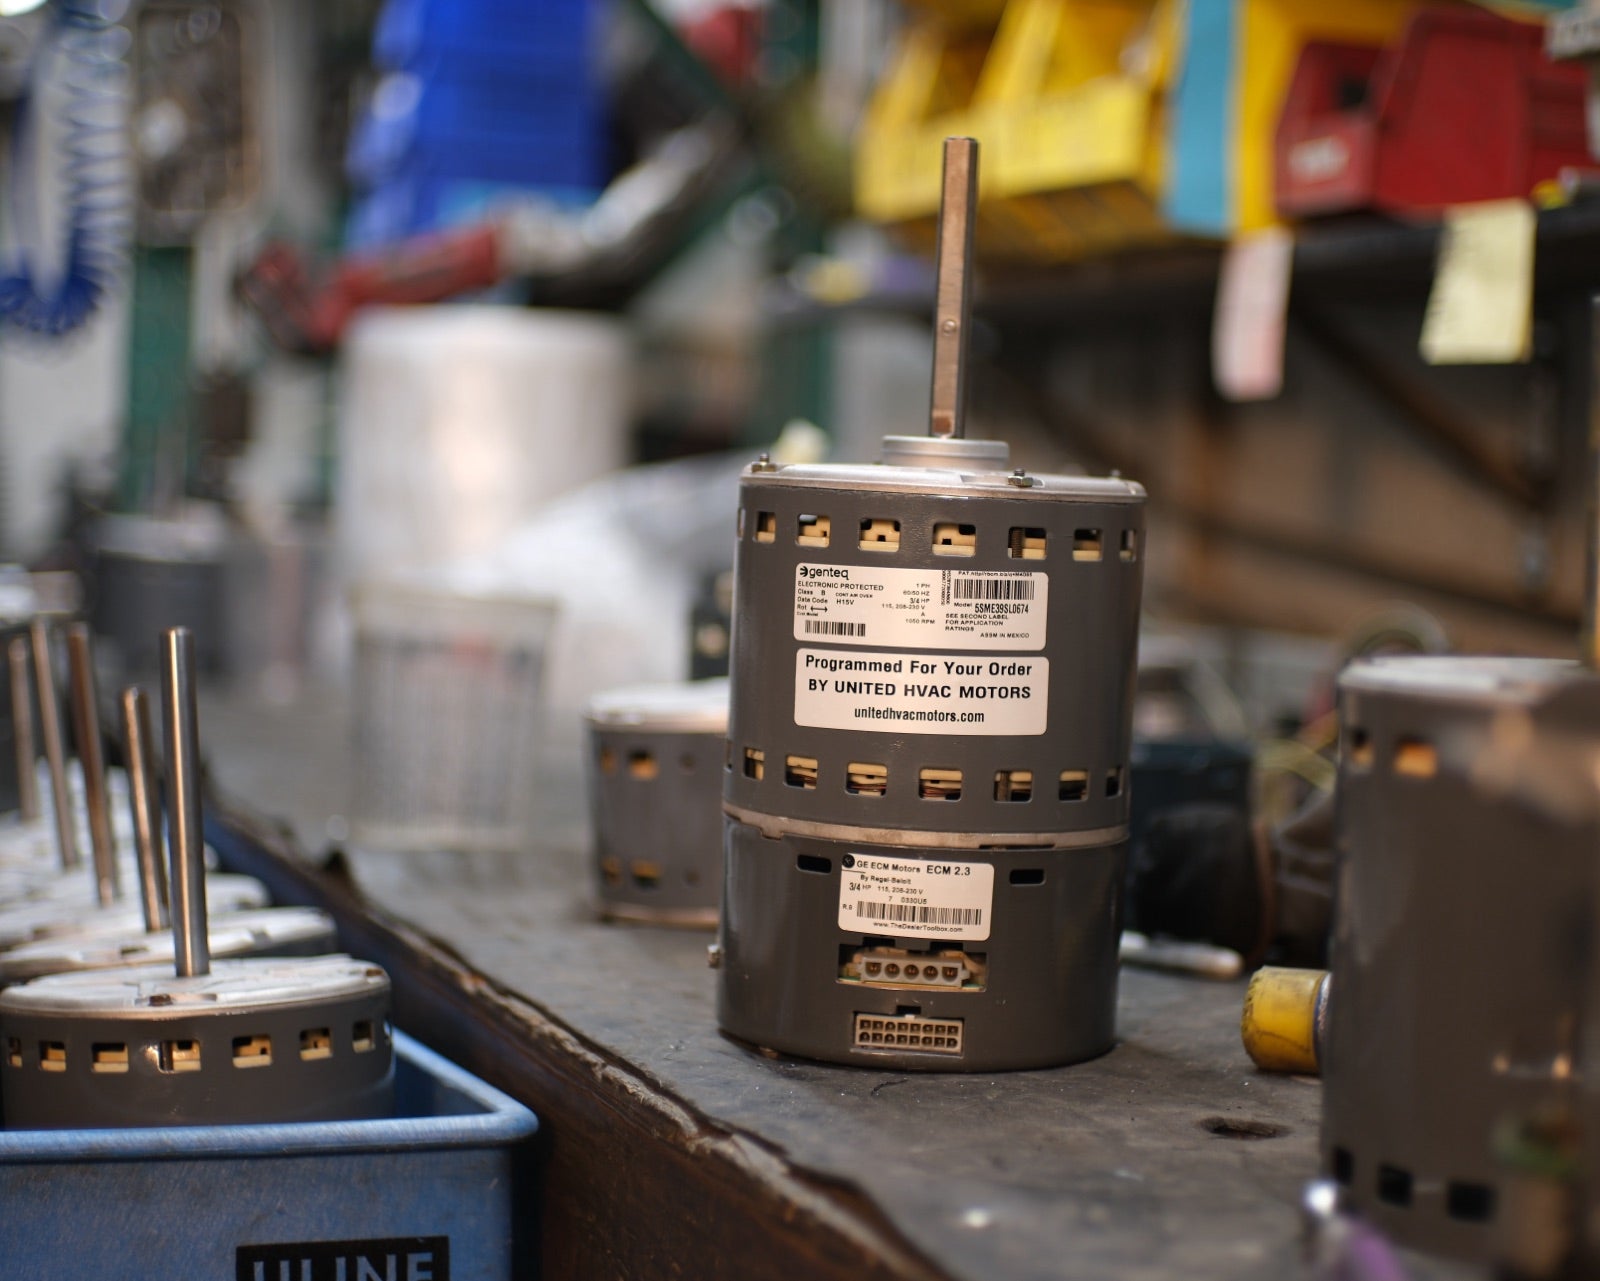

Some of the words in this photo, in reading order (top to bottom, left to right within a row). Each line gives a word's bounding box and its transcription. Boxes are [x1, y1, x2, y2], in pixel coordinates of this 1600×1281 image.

[809, 567, 849, 580] genteq
[975, 603, 1029, 614] 5SME39SL0674
[806, 654, 902, 673] Programmed
[910, 661, 937, 674] For
[944, 661, 983, 676] Your
[988, 662, 1032, 676] Order
[808, 678, 828, 692] BY
[834, 680, 896, 696] UNITED
[904, 684, 952, 698] HVAC
[959, 685, 1031, 699] MOTORS
[854, 706, 984, 723] unitedhvacmotors.com
[857, 860, 868, 868] GE
[892, 864, 921, 873] Motors
[926, 865, 951, 875] ECM
[954, 866, 971, 876] 2.3
[849, 882, 861, 891] 3/4
[873, 922, 963, 932] www.TheDealerToolbox.com
